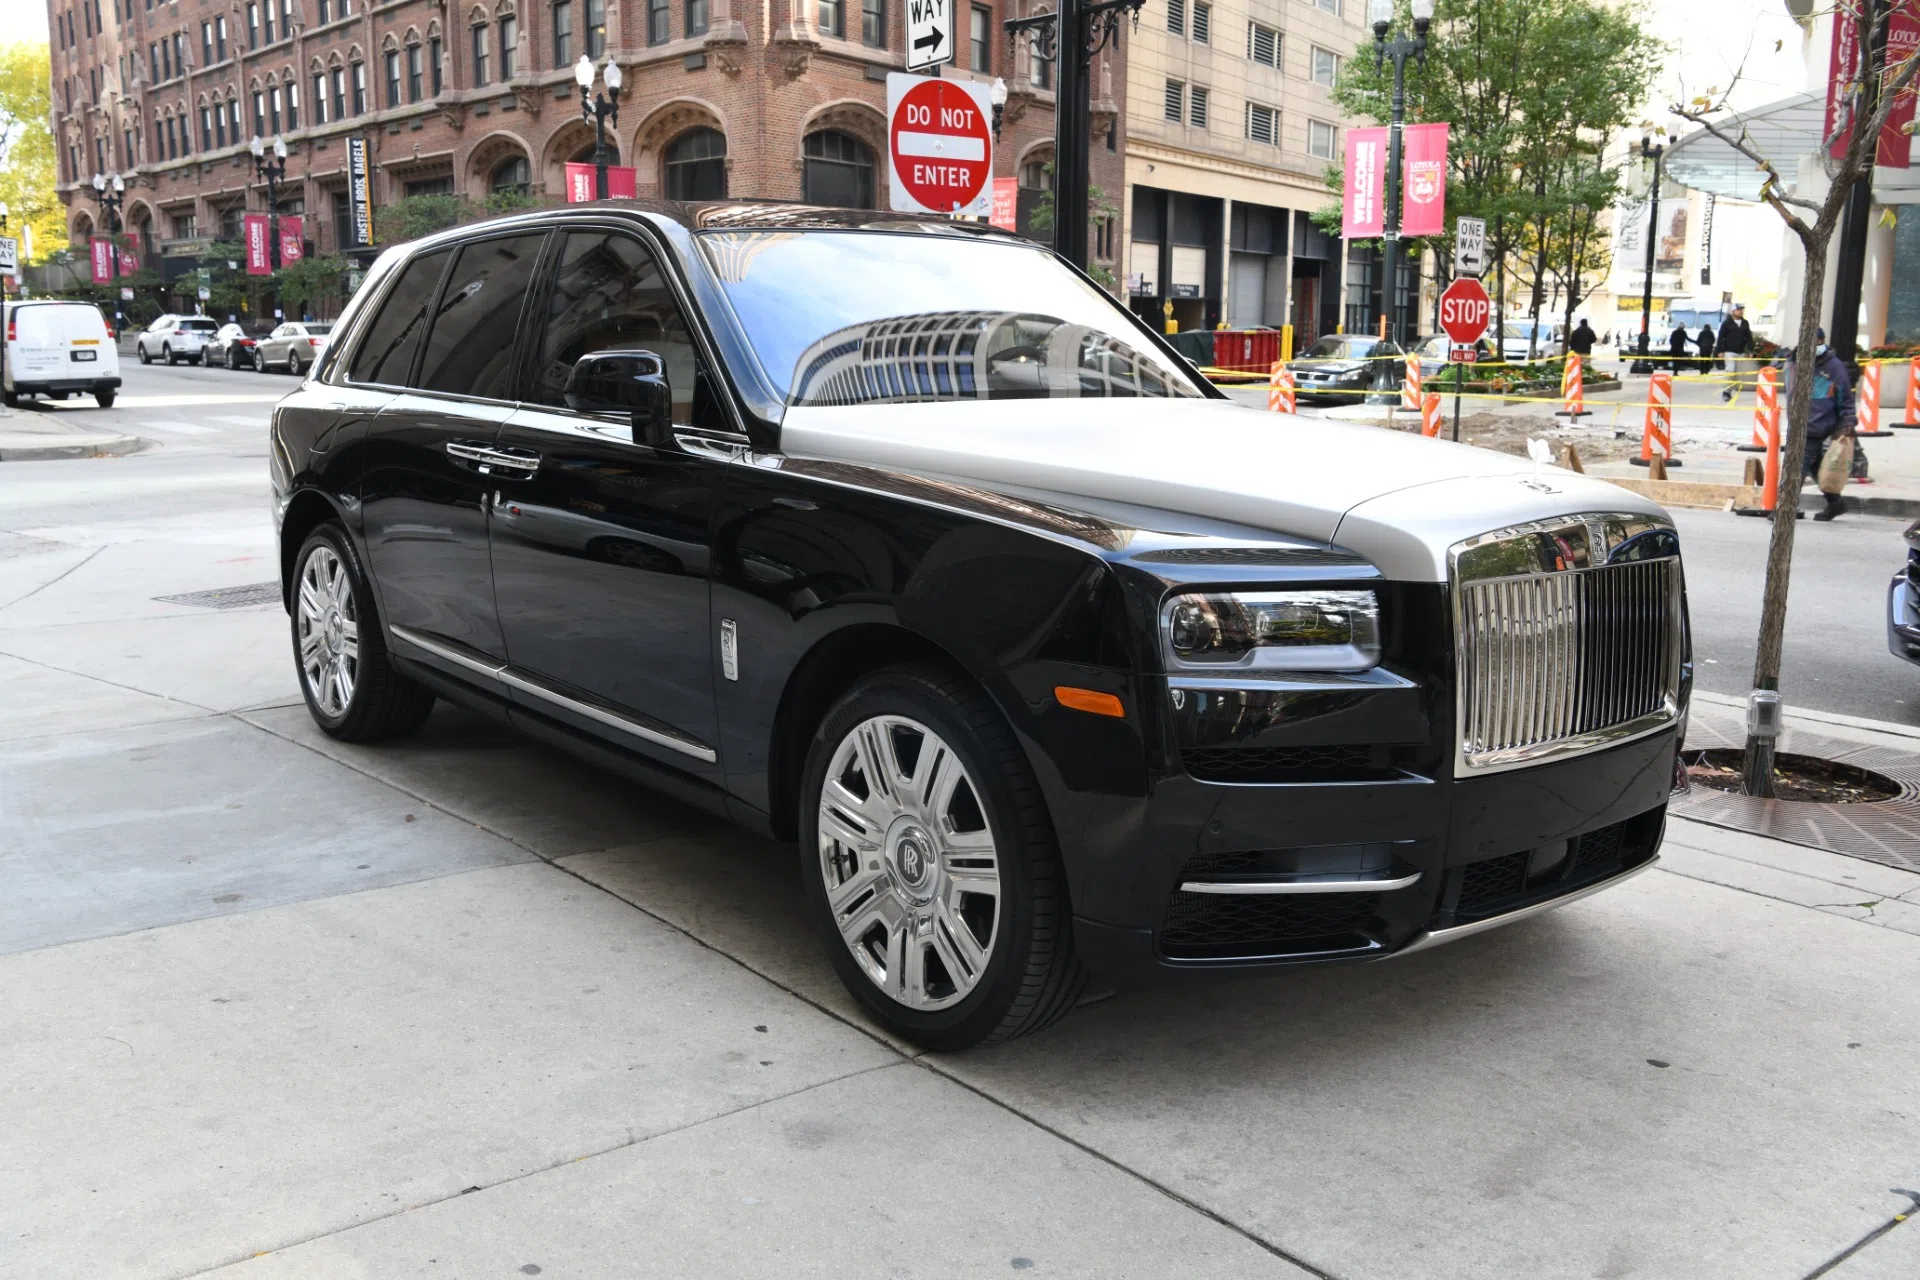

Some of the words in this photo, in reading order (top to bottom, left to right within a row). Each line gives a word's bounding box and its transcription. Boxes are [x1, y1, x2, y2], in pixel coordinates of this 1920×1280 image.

[911, 0, 943, 24] WAY
[1888, 29, 1919, 42] LOYOL
[907, 104, 931, 125] DO
[941, 108, 974, 130] NOT
[352, 140, 365, 175] BAGELS
[1410, 161, 1441, 169] LOYOLA
[914, 164, 970, 188] ENTER
[1353, 142, 1368, 224] WELCOME
[356, 203, 369, 244] EINSTEIN
[1460, 222, 1481, 237] ONE
[0, 241, 13, 250] NE
[251, 222, 260, 267] WELCOME
[1460, 237, 1481, 250] WAY
[0, 252, 13, 260] AY
[1443, 298, 1487, 324] STOP
[1453, 351, 1462, 360] ALL
[1463, 351, 1474, 361] WAY
